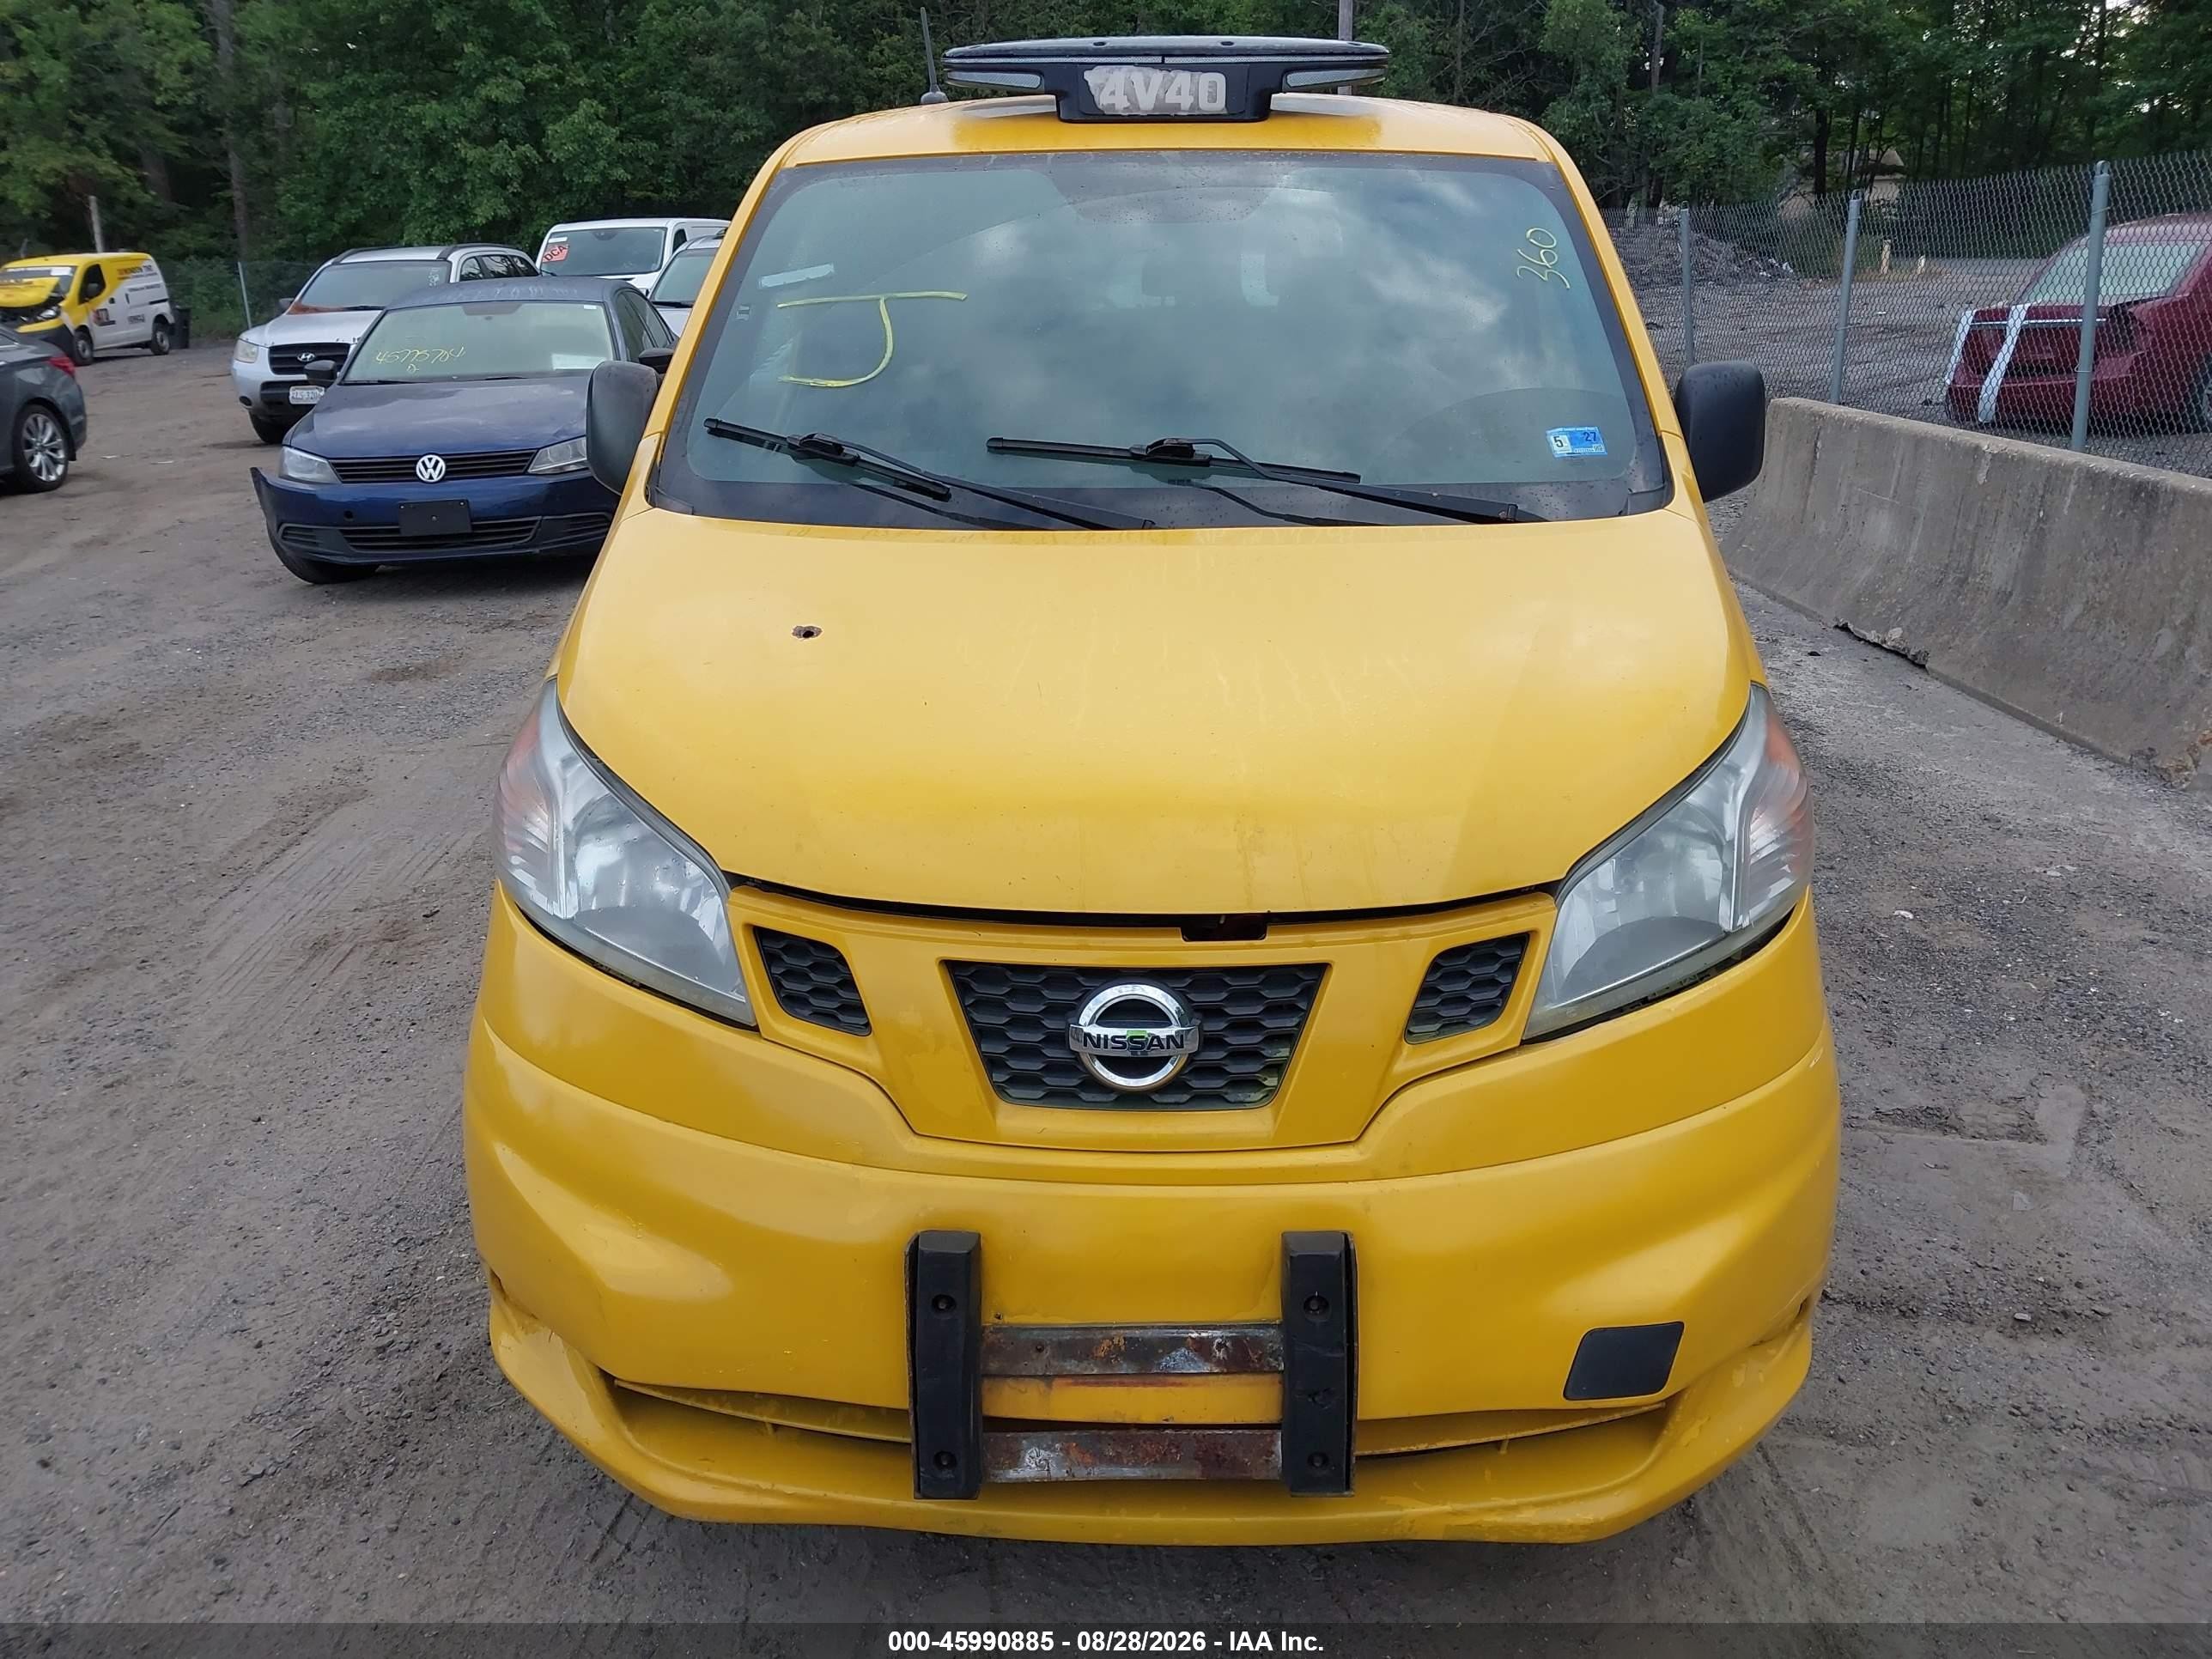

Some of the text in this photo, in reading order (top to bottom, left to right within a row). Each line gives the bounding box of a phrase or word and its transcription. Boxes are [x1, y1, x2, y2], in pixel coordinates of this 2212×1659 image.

[1098, 70, 1227, 112] 4V40
[544, 245, 567, 261] DCA
[1516, 226, 1571, 290] 360
[1553, 435, 1564, 448] 5
[1583, 431, 1597, 442] 27
[1082, 1032, 1185, 1052] NISSAN
